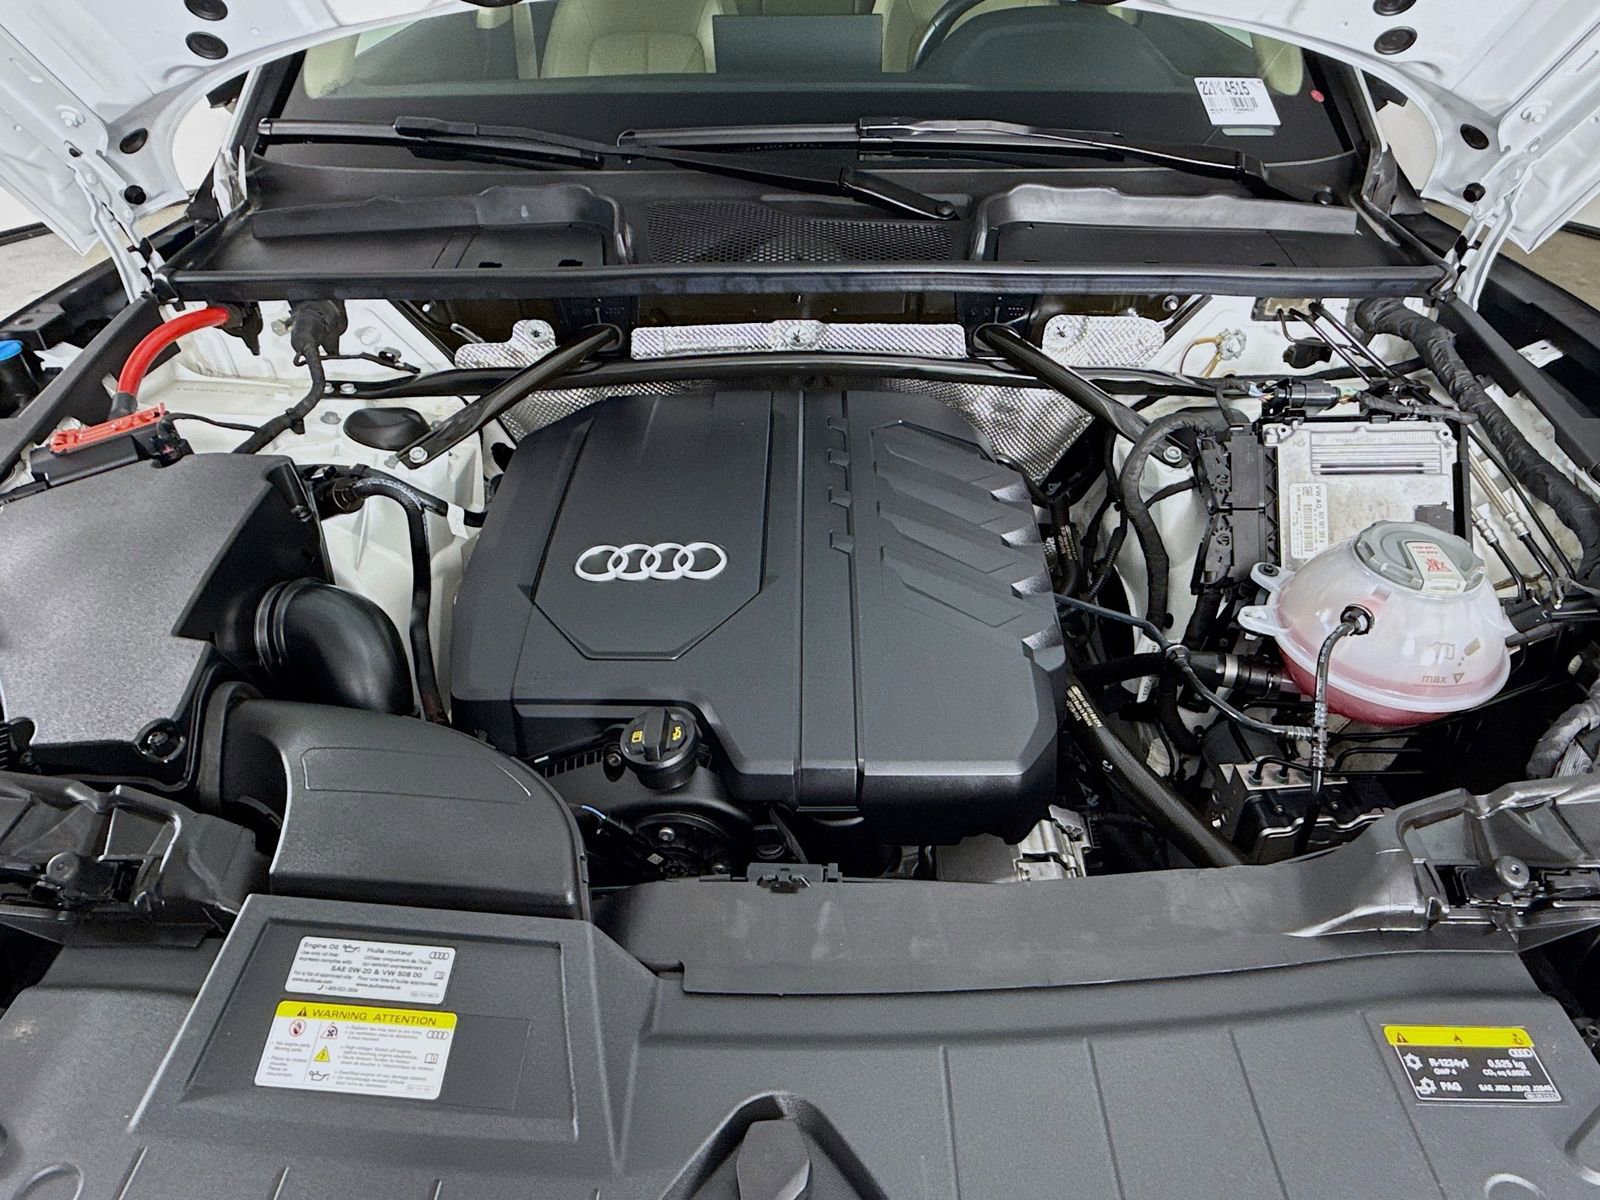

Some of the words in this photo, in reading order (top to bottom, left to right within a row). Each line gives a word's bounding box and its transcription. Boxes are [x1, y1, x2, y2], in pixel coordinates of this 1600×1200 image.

[1420, 673, 1447, 684] max
[386, 948, 414, 956] moteur
[382, 969, 396, 977] VW
[312, 1008, 367, 1021] WARNING
[373, 1012, 437, 1026] ATTENTION
[1512, 1059, 1527, 1070] kg
[1440, 1081, 1463, 1092] PAG
